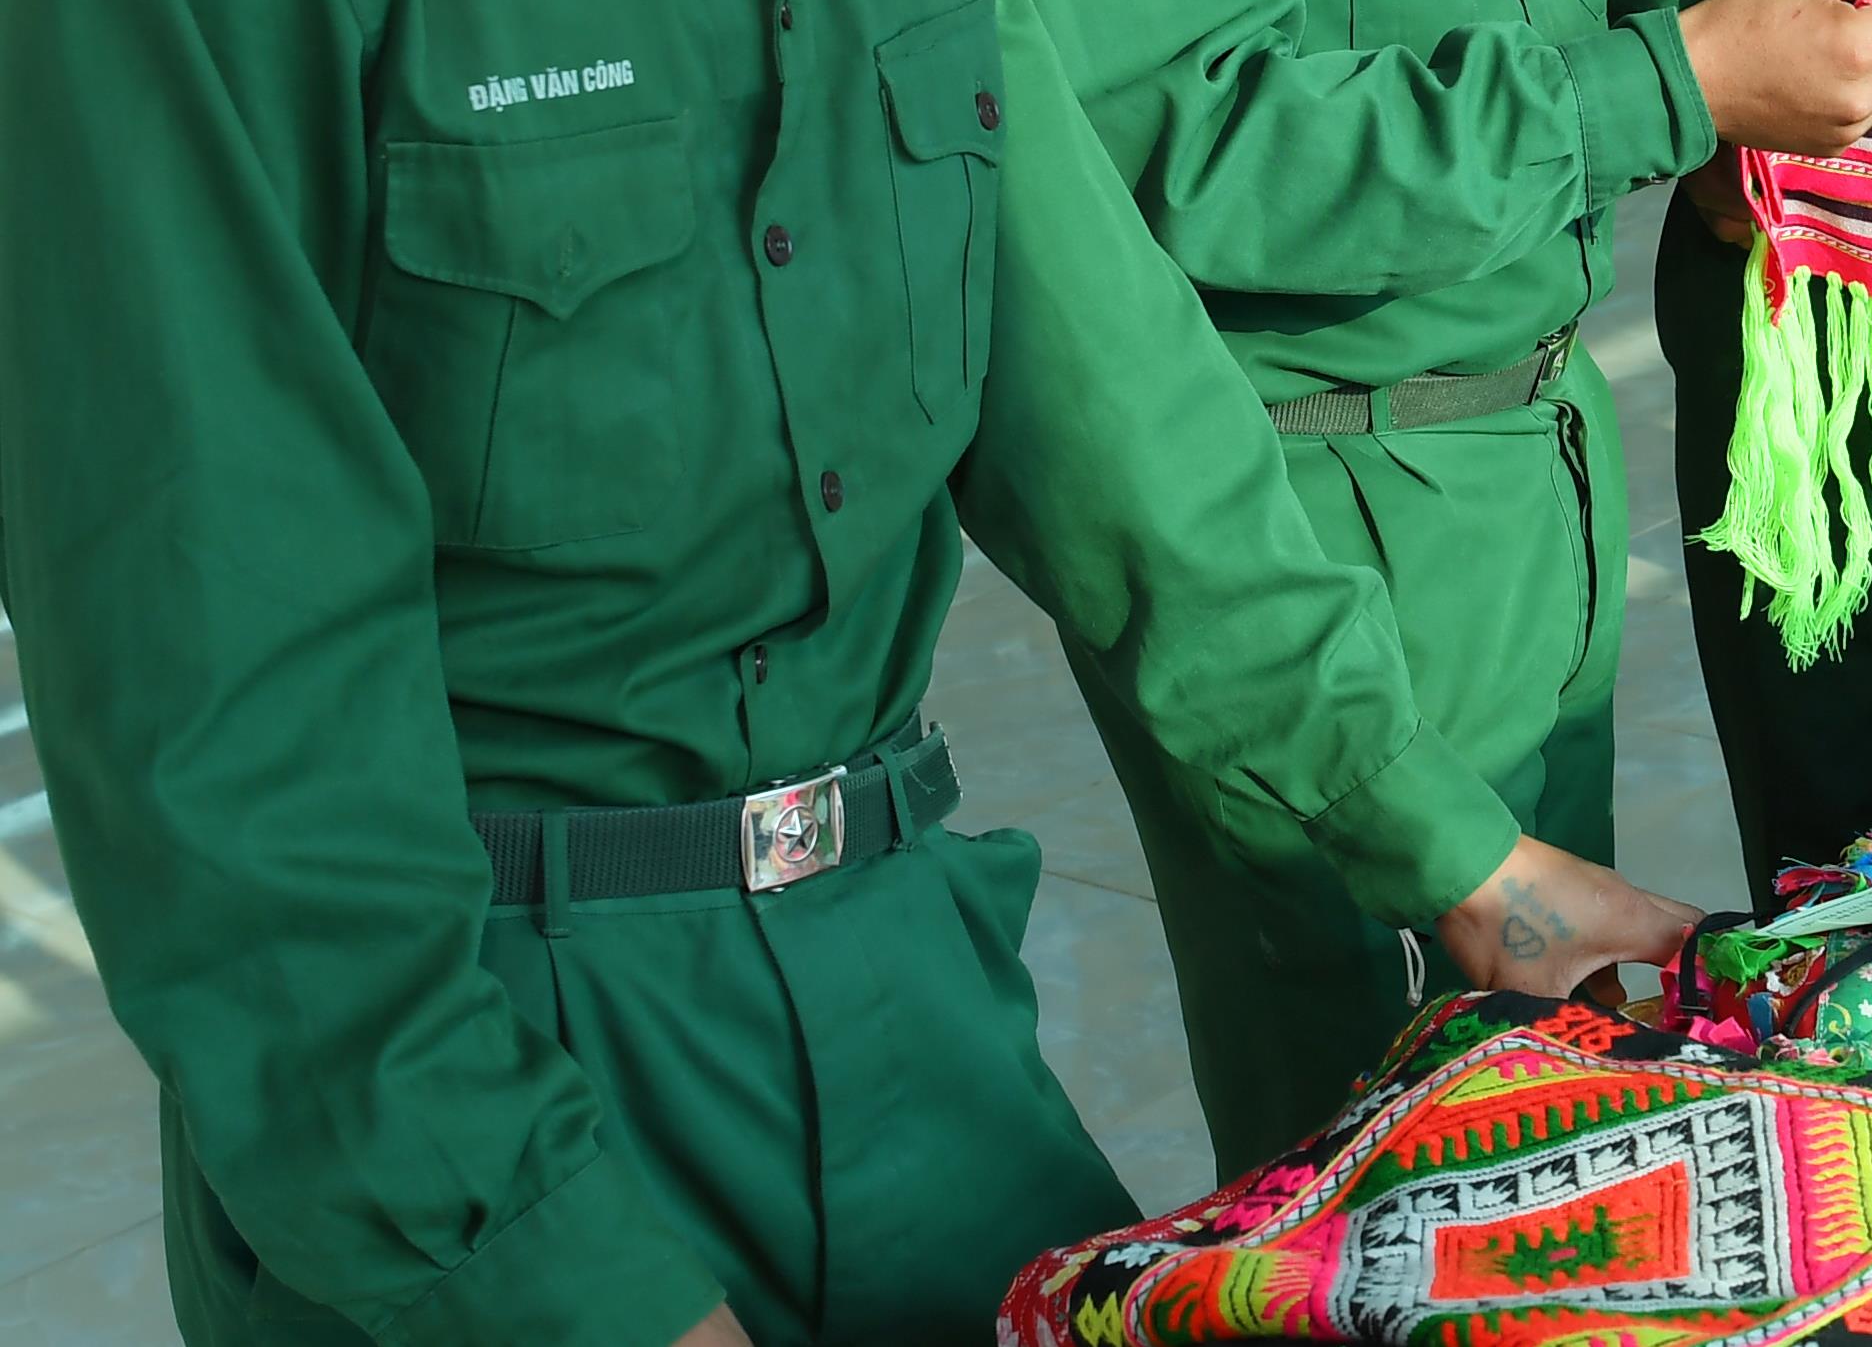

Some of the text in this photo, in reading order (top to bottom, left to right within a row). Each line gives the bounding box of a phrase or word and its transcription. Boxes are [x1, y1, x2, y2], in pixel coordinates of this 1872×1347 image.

[468, 59, 635, 112] ĐẶNG VĂN CÔNG
